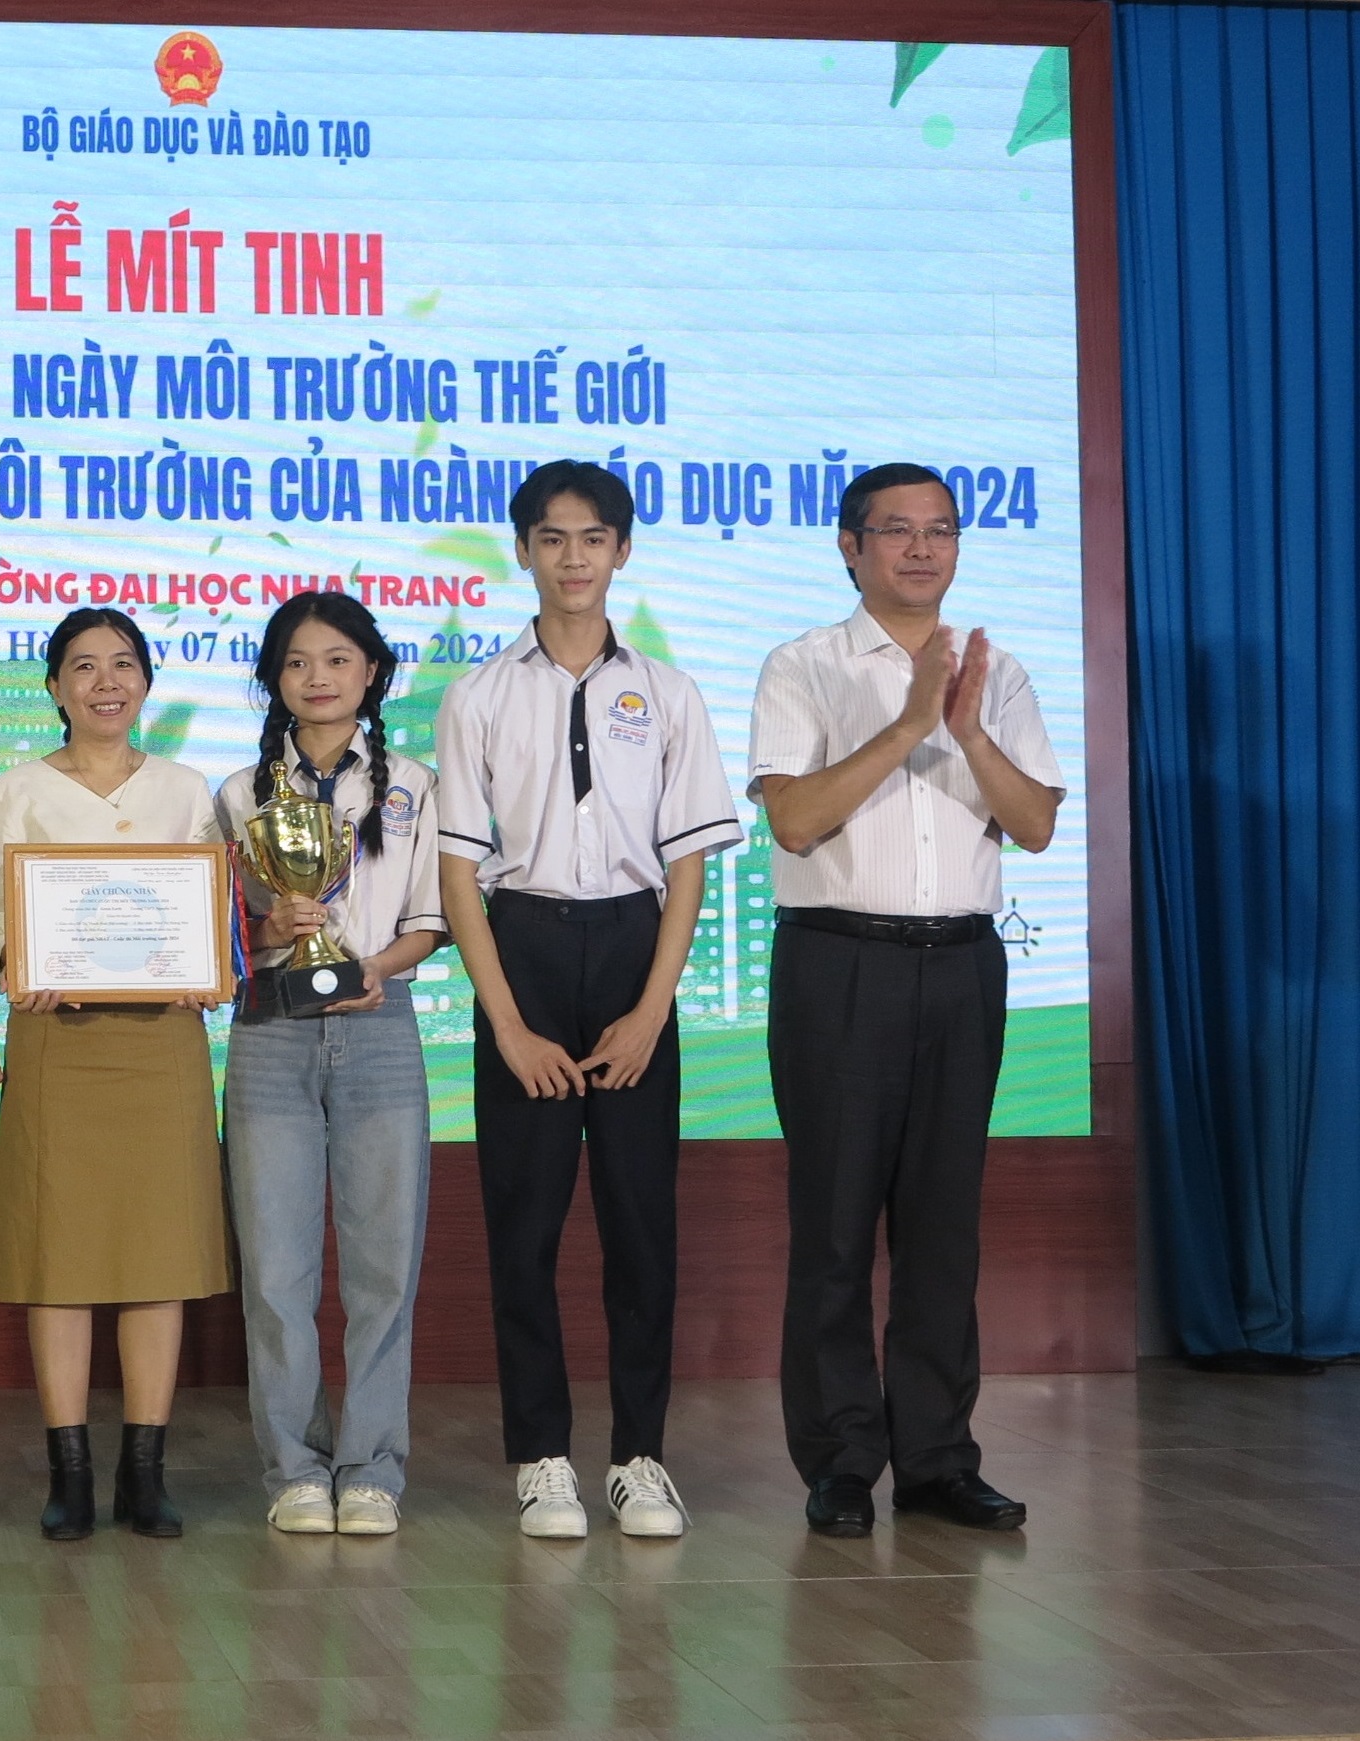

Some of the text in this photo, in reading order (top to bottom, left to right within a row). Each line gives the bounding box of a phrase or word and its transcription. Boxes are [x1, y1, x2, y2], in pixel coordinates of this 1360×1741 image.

[23, 107, 370, 165] BỘ GIÁO DỤC VÀ ĐÀO TẠO
[15, 201, 384, 316] LỄ MÍT TINH
[14, 338, 139, 419] NGÀY
[156, 338, 249, 420] MÔI
[267, 340, 457, 423] TRƯỜNG
[474, 345, 566, 424] THẾ
[576, 345, 665, 425] GIỚI
[60, 437, 252, 522] TRƯỜNG
[270, 436, 363, 522] CỦA
[681, 462, 772, 540] DỤC
[789, 448, 870, 527] NĂ
[923, 465, 1038, 529] 024
[87, 573, 158, 616] ĐẠI
[168, 573, 252, 617] HỌC
[354, 575, 486, 607] TRANG
[7, 631, 50, 662] Hò
[181, 631, 218, 662] 07
[430, 632, 500, 663] 2024
